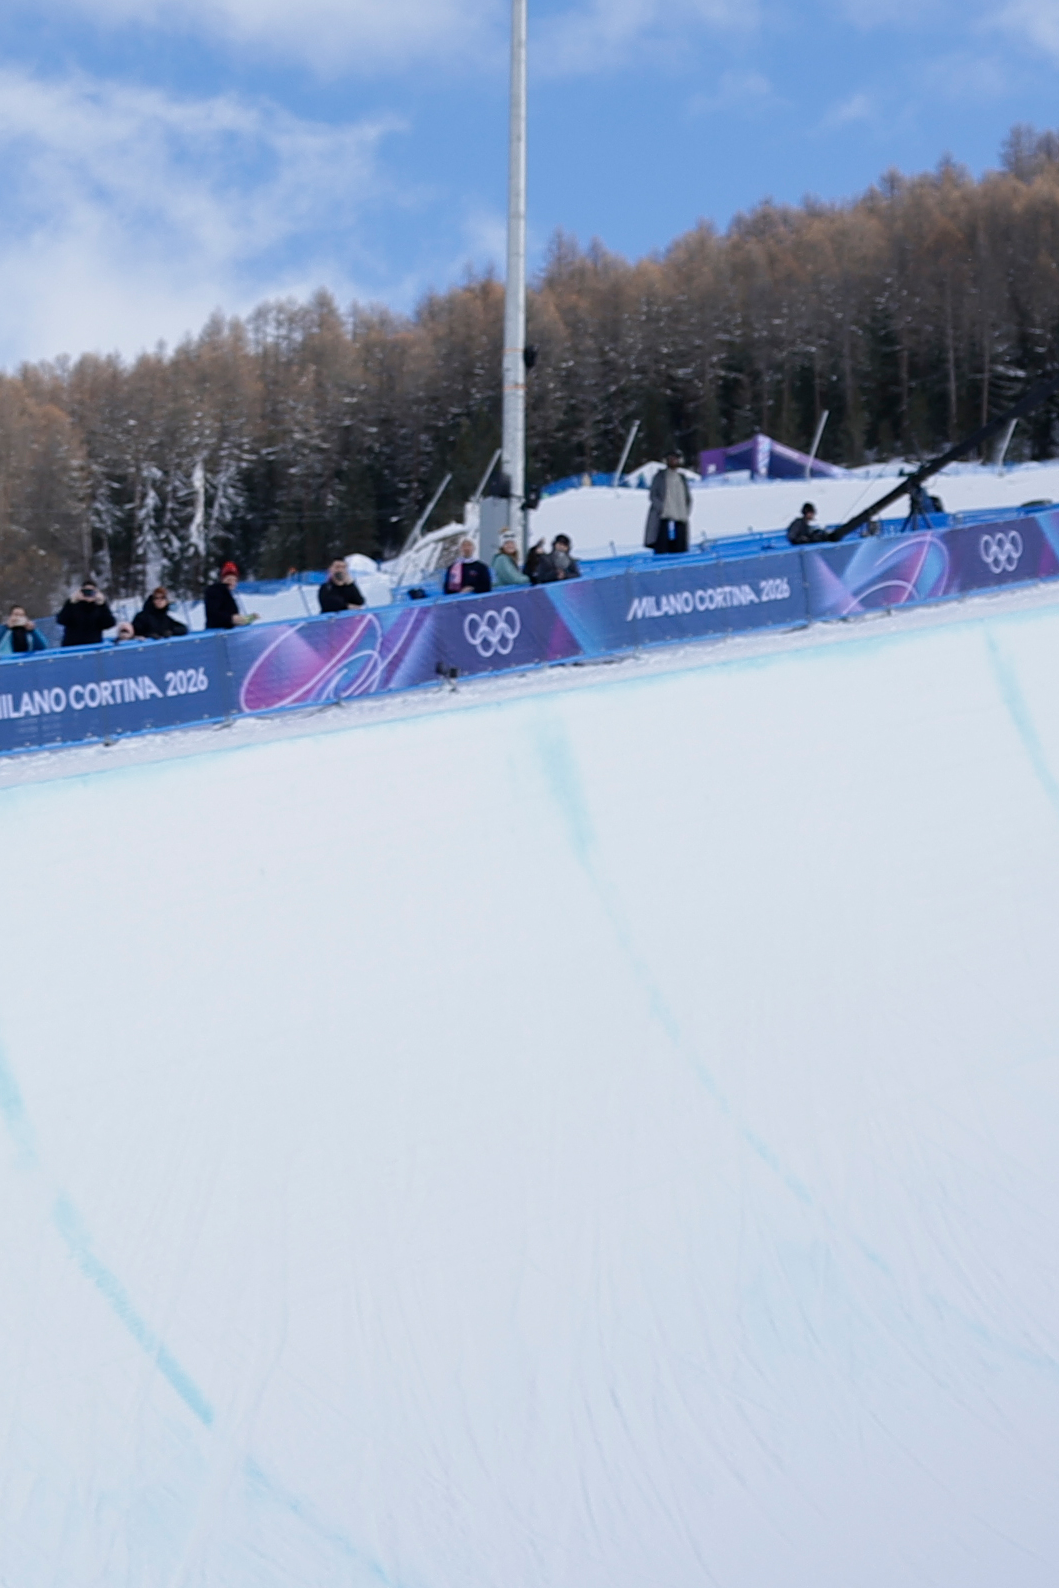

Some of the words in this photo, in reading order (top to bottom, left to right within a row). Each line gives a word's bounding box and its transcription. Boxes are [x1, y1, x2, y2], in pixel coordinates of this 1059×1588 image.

[626, 590, 693, 622] MILANO
[694, 583, 760, 611] CORTINA
[758, 576, 791, 602] 2026
[68, 675, 164, 710] CORTINA
[164, 666, 209, 697] 2026
